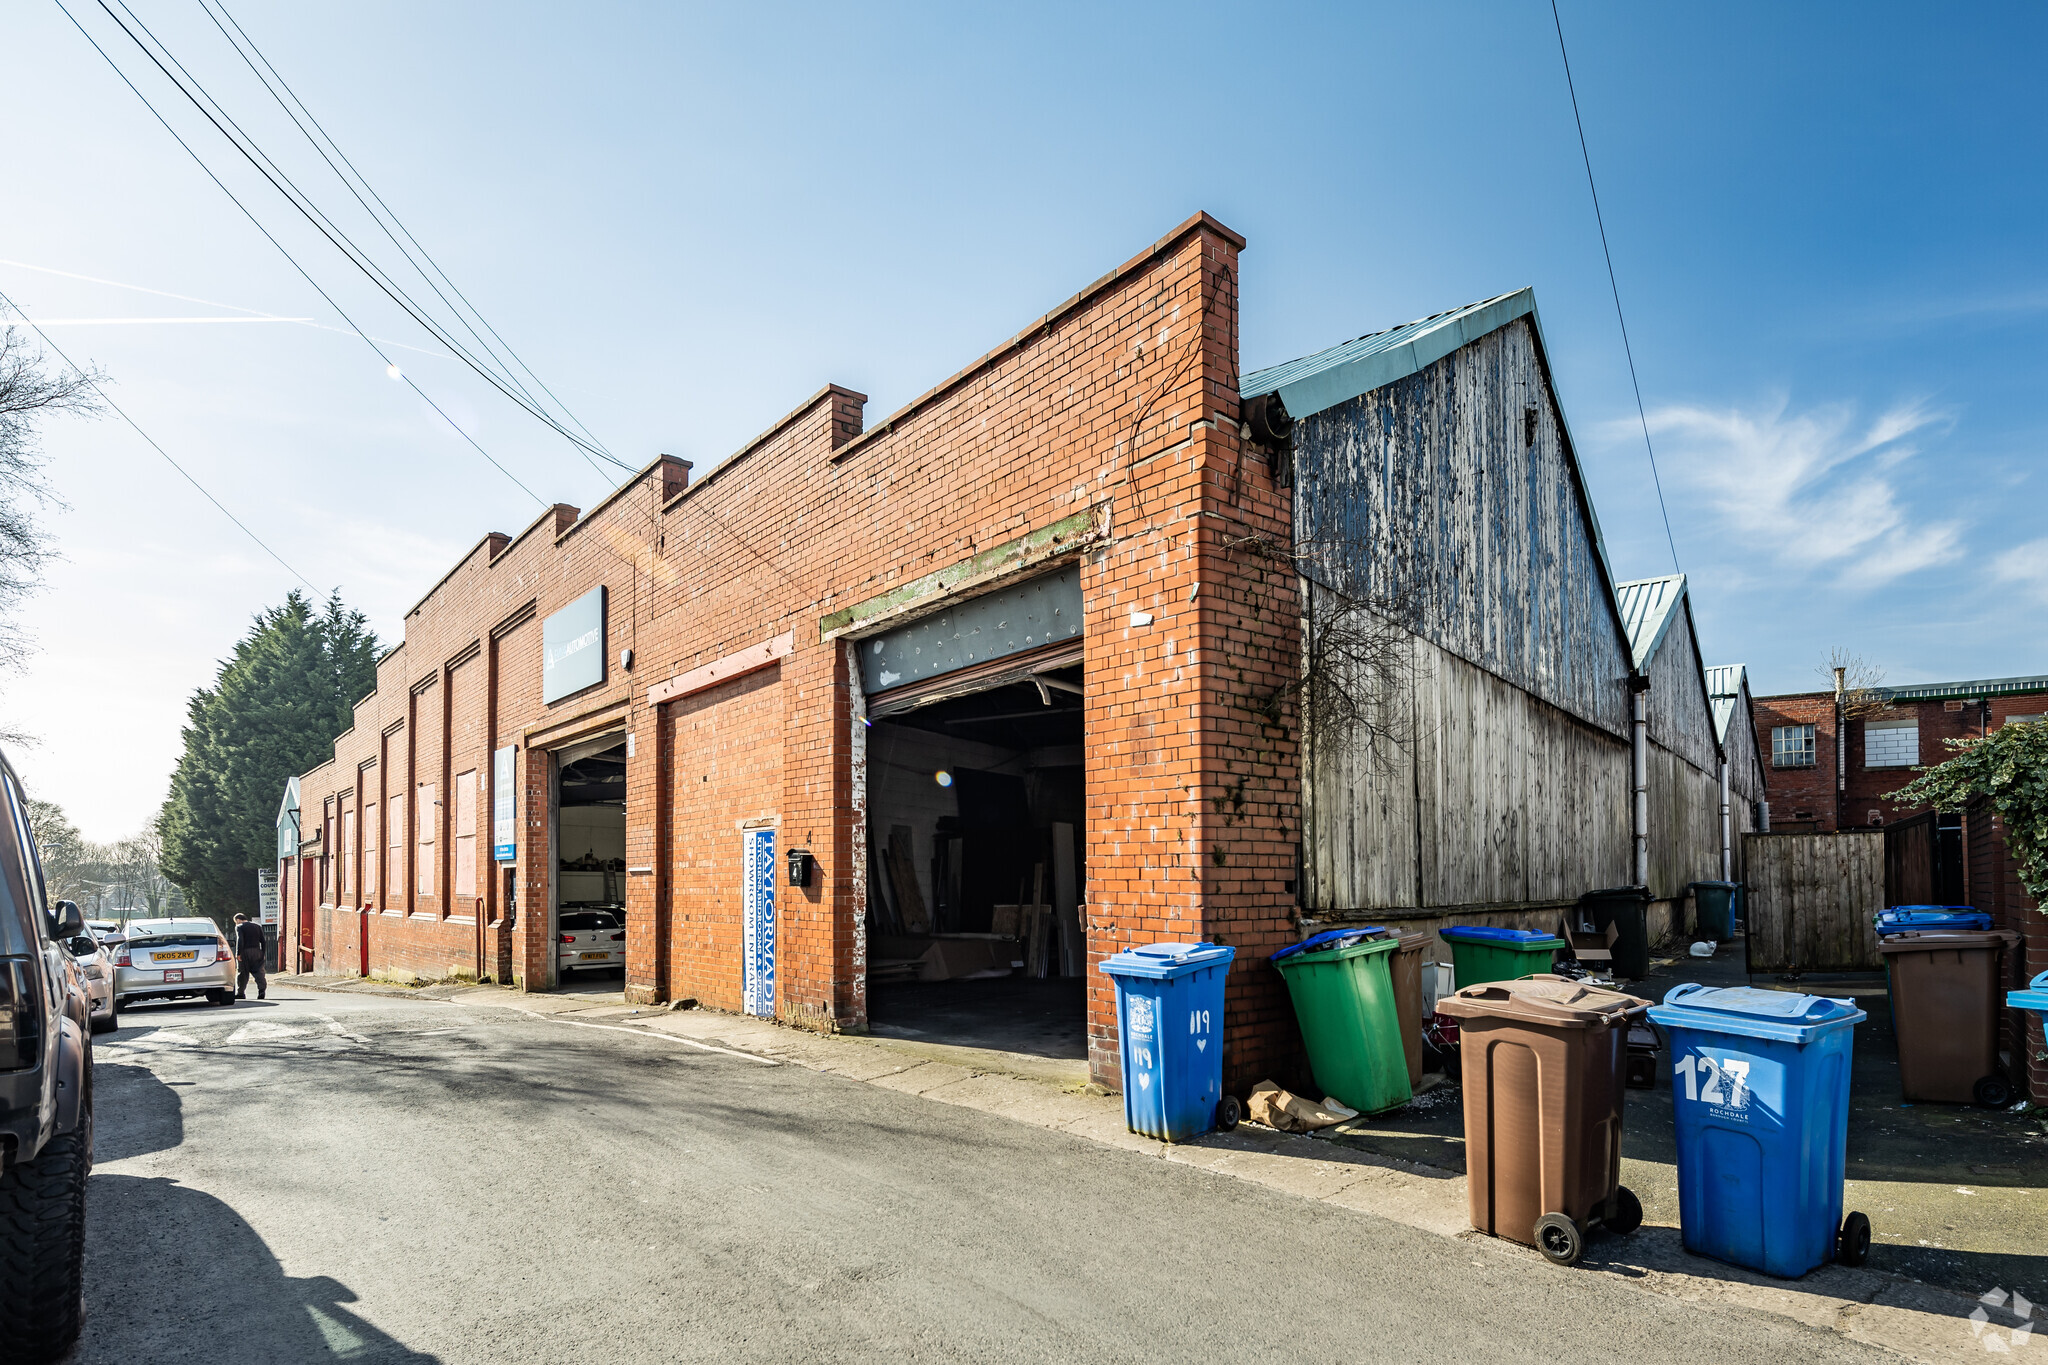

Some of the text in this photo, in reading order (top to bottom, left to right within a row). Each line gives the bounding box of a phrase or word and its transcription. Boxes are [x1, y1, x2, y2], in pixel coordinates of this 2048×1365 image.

[764, 835, 774, 1015] TAYLORMADE
[1190, 1010, 1210, 1035] 119
[1133, 1045, 1153, 1070] 119
[1675, 1054, 1750, 1107] 127
[1709, 1108, 1749, 1120] ROCHDALE
